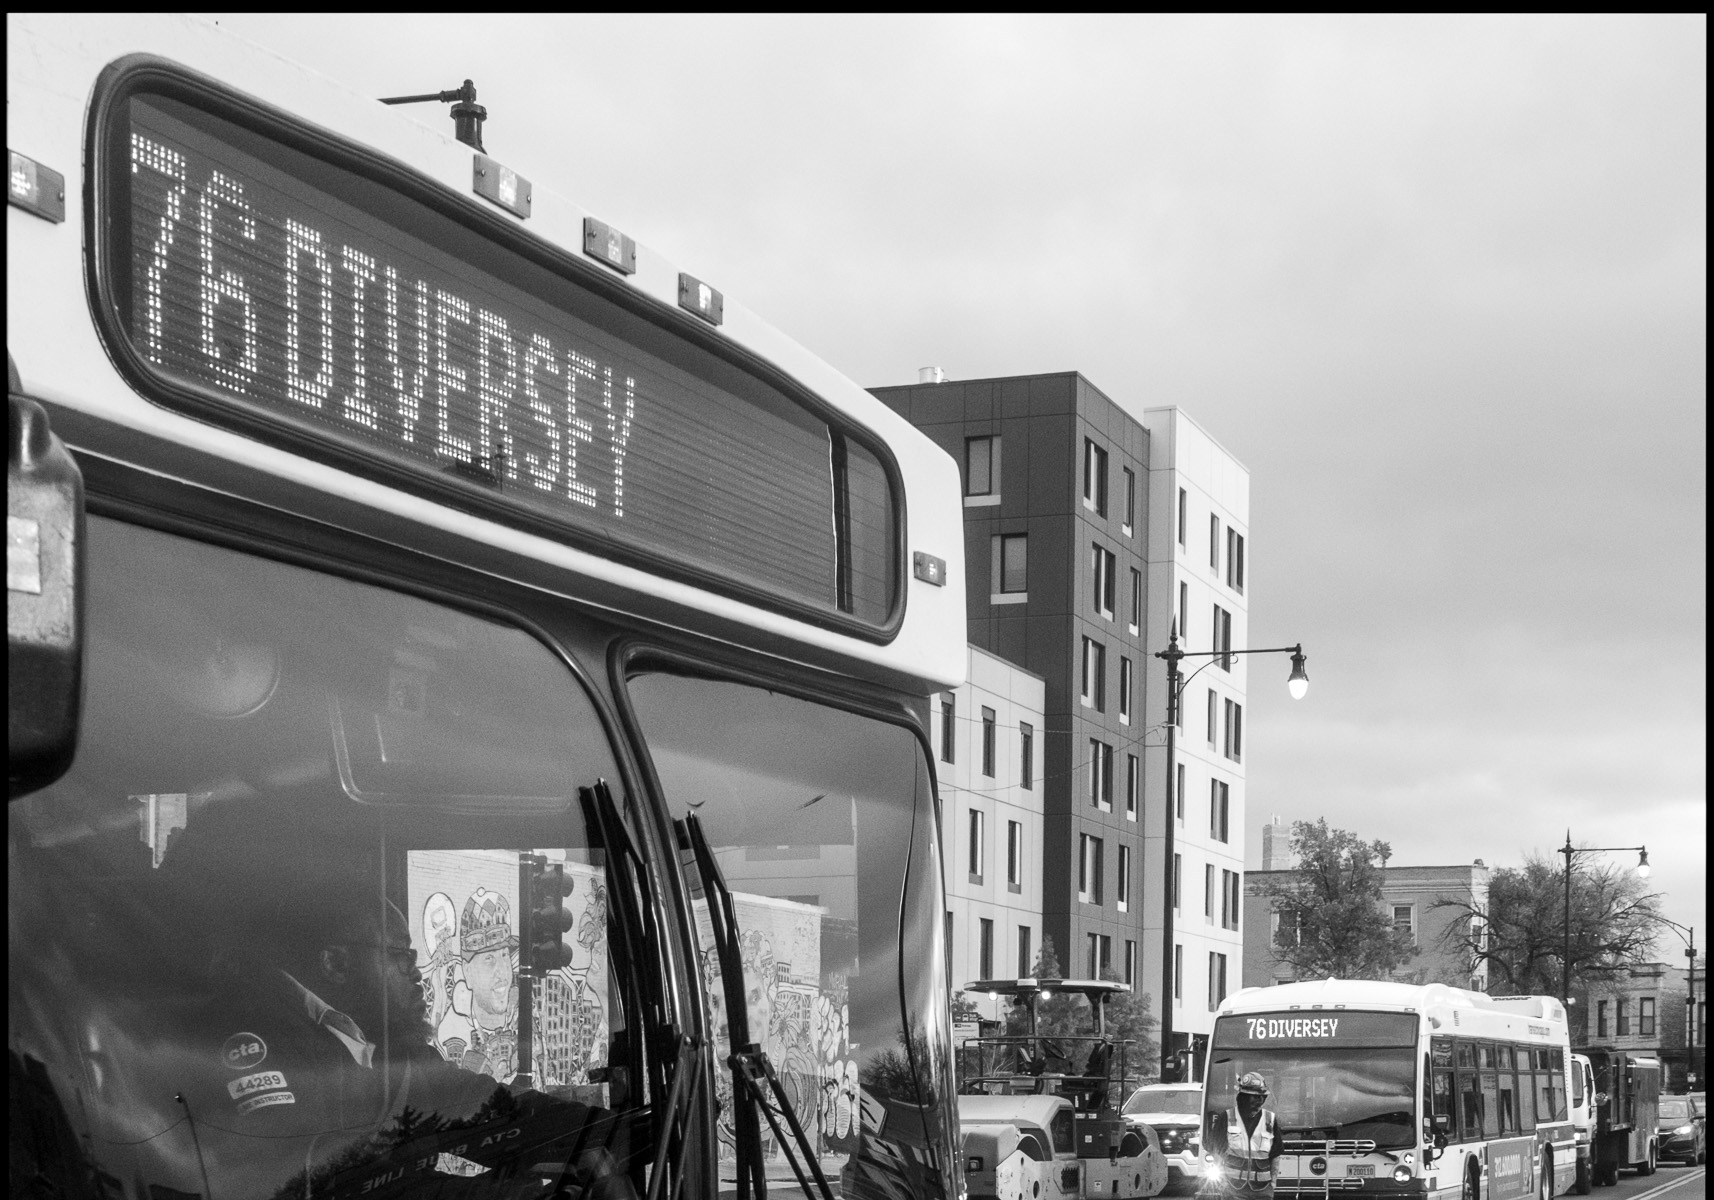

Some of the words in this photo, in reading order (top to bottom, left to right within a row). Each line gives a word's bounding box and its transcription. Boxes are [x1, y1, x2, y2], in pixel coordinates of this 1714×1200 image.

[131, 132, 258, 394] 76
[286, 217, 636, 518] DIVERSEY
[1247, 1018, 1266, 1039] 76
[1269, 1019, 1338, 1038] DIVERSEY
[228, 1042, 260, 1061] cta
[235, 1074, 281, 1093] 44289
